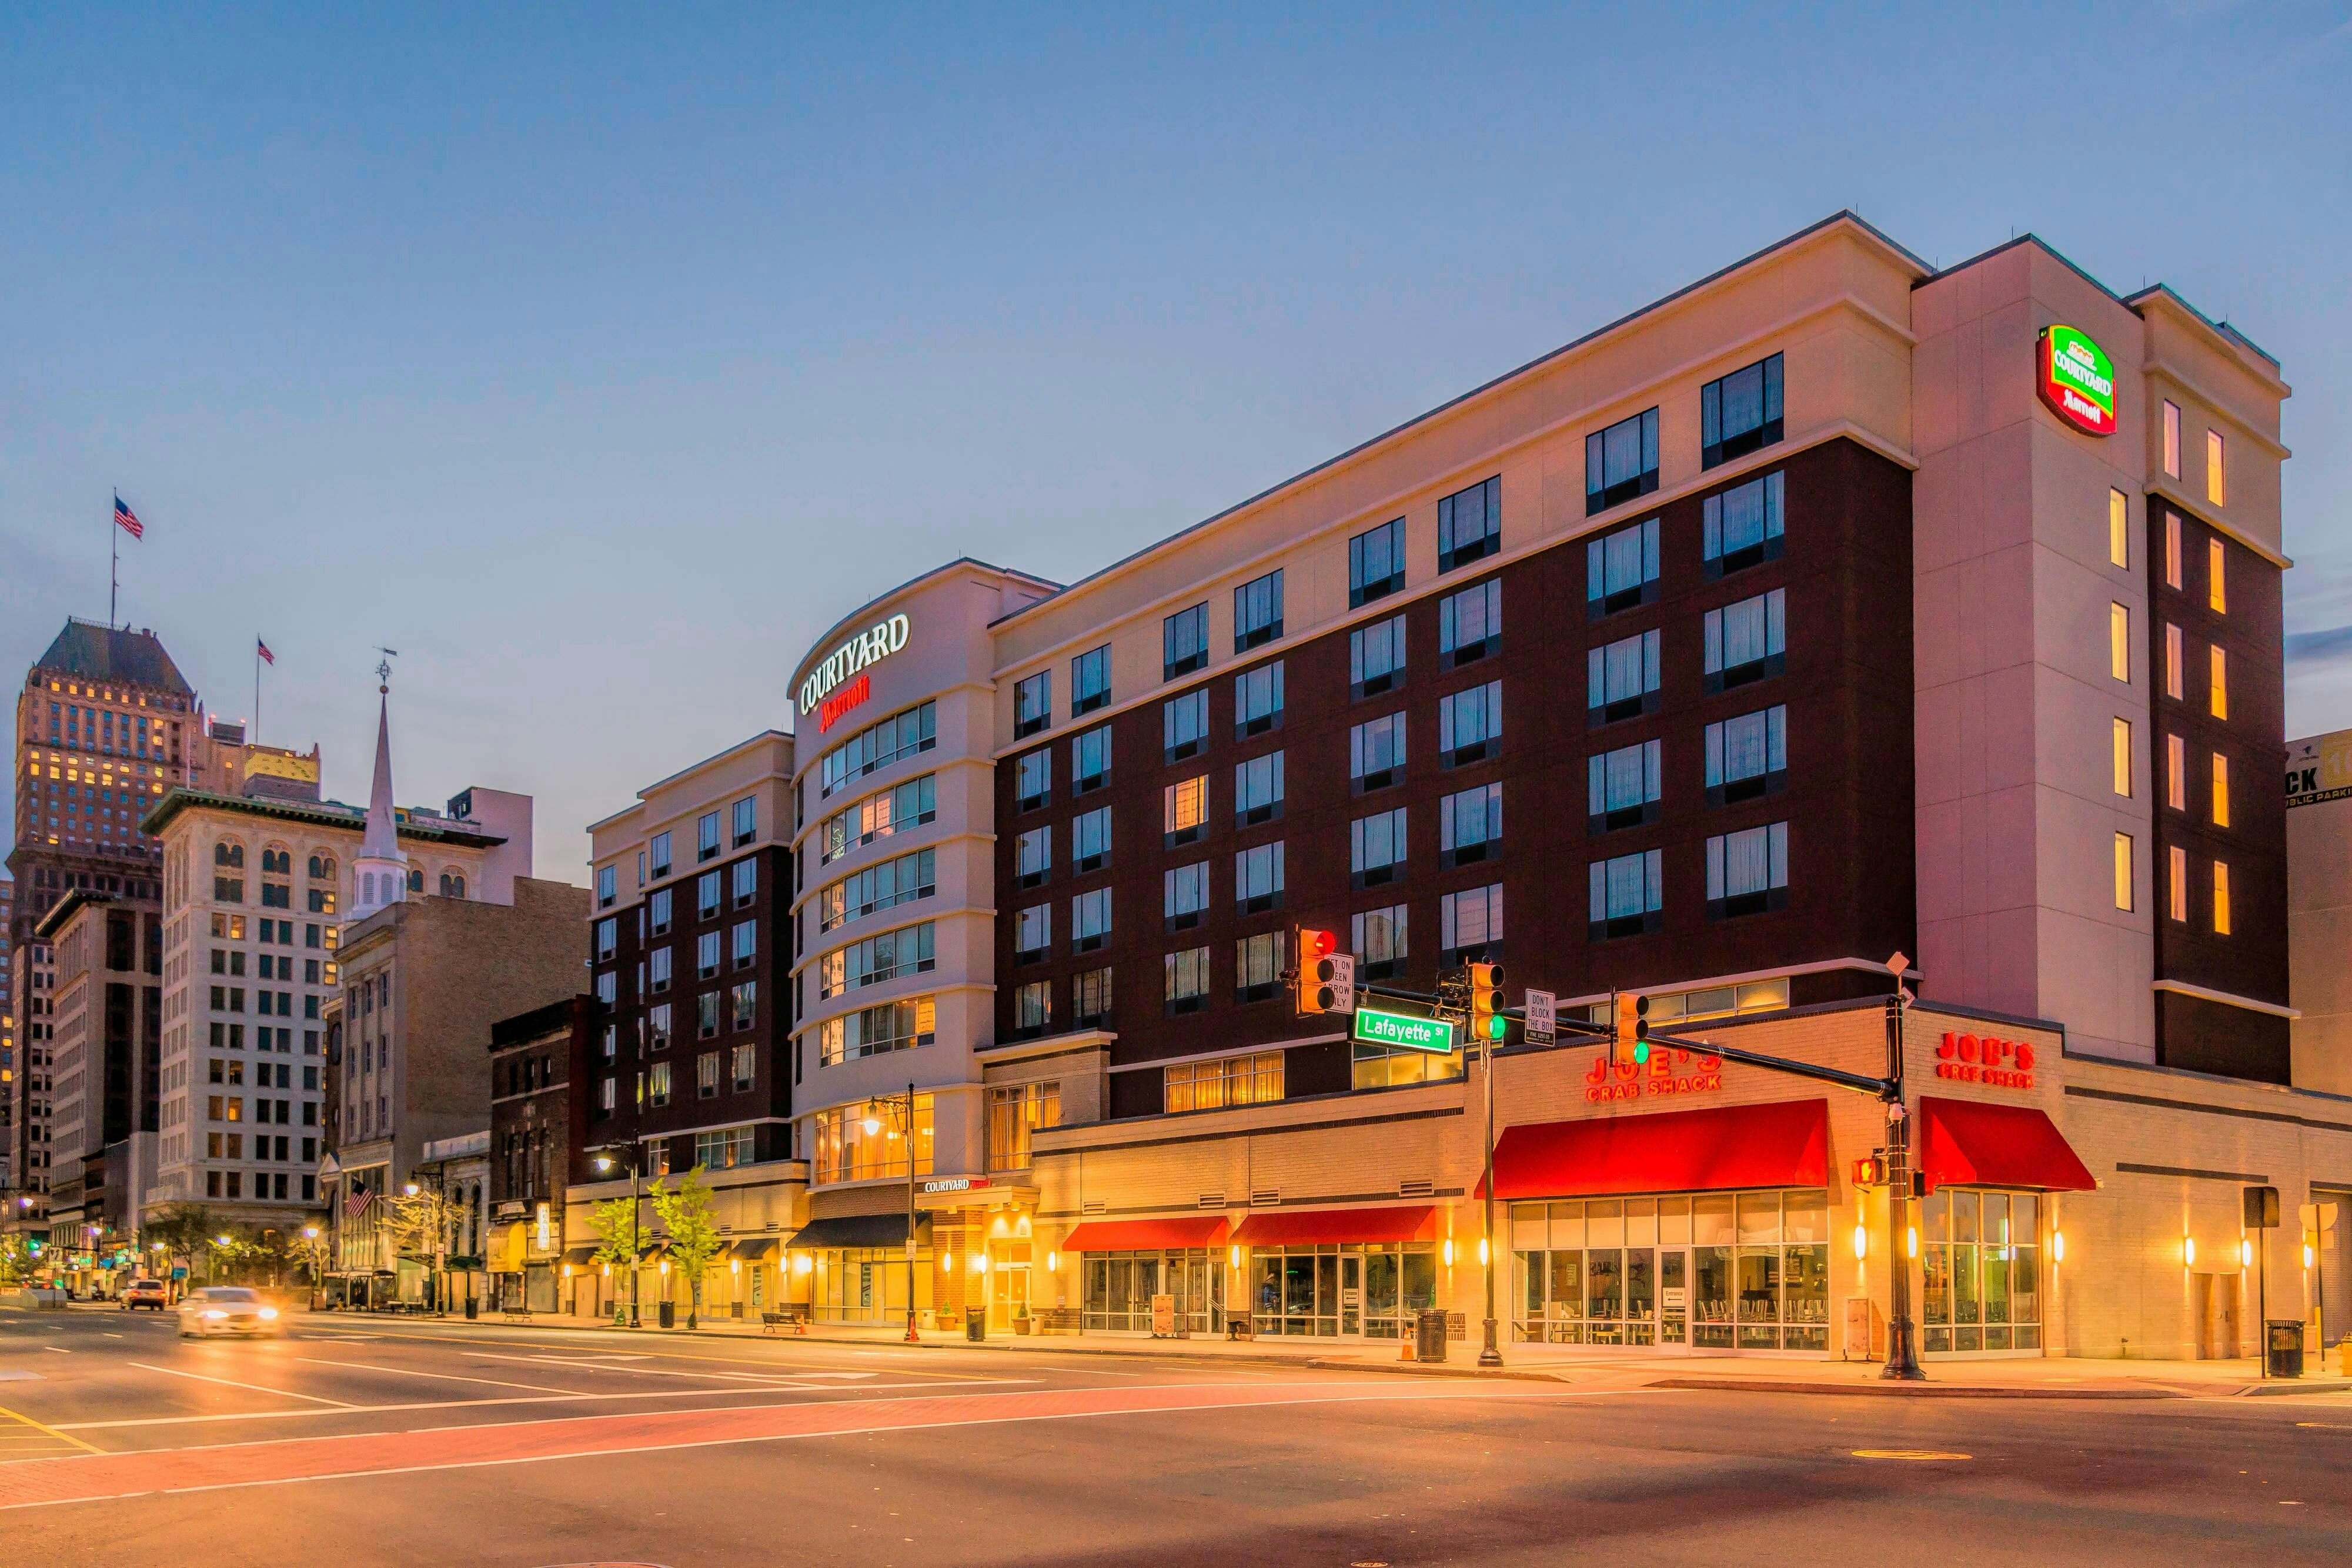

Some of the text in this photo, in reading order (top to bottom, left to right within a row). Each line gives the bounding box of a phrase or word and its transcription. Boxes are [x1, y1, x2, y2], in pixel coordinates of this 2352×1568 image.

[2054, 350, 2111, 396] COURTYARD
[2064, 389, 2100, 424] Marriott
[800, 614, 909, 716] COURTYARD
[820, 675, 870, 733] Marriott
[1342, 961, 1350, 970] ON
[1531, 1007, 1549, 1019] BLOCK
[1532, 995, 1549, 1007] DON'T
[1365, 1016, 1444, 1042] Lafayette St
[1528, 1019, 1553, 1032] THE BOX
[1936, 1030, 2034, 1070] JOE'S
[1586, 1075, 1722, 1101] CRAB SHACK
[1936, 1062, 2034, 1089] CRAB SHACK
[925, 1179, 969, 1192] COURTYARD
